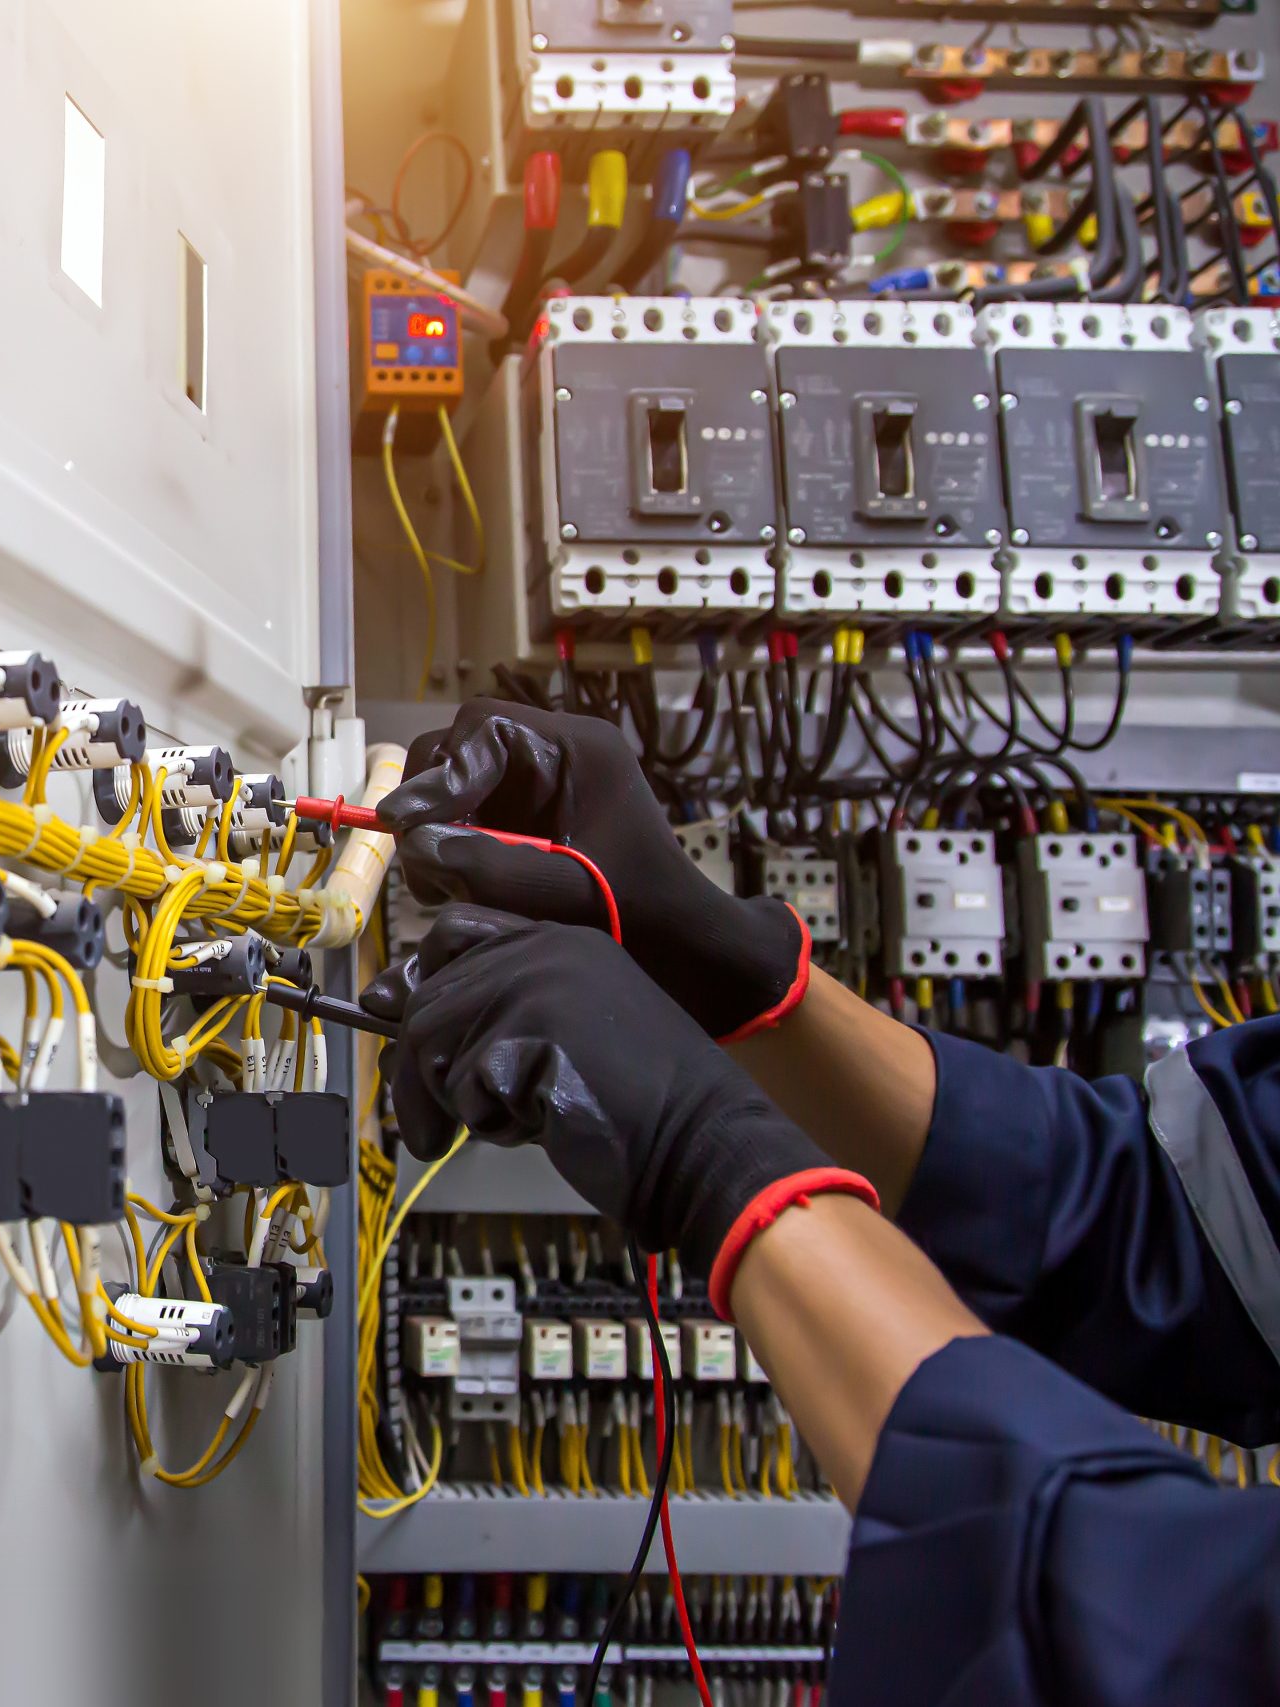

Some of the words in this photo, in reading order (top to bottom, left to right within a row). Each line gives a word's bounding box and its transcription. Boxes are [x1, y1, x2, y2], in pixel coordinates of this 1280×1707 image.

[247, 1055, 255, 1073] 113
[269, 1224, 280, 1242] 113
[278, 1230, 291, 1248] 113
